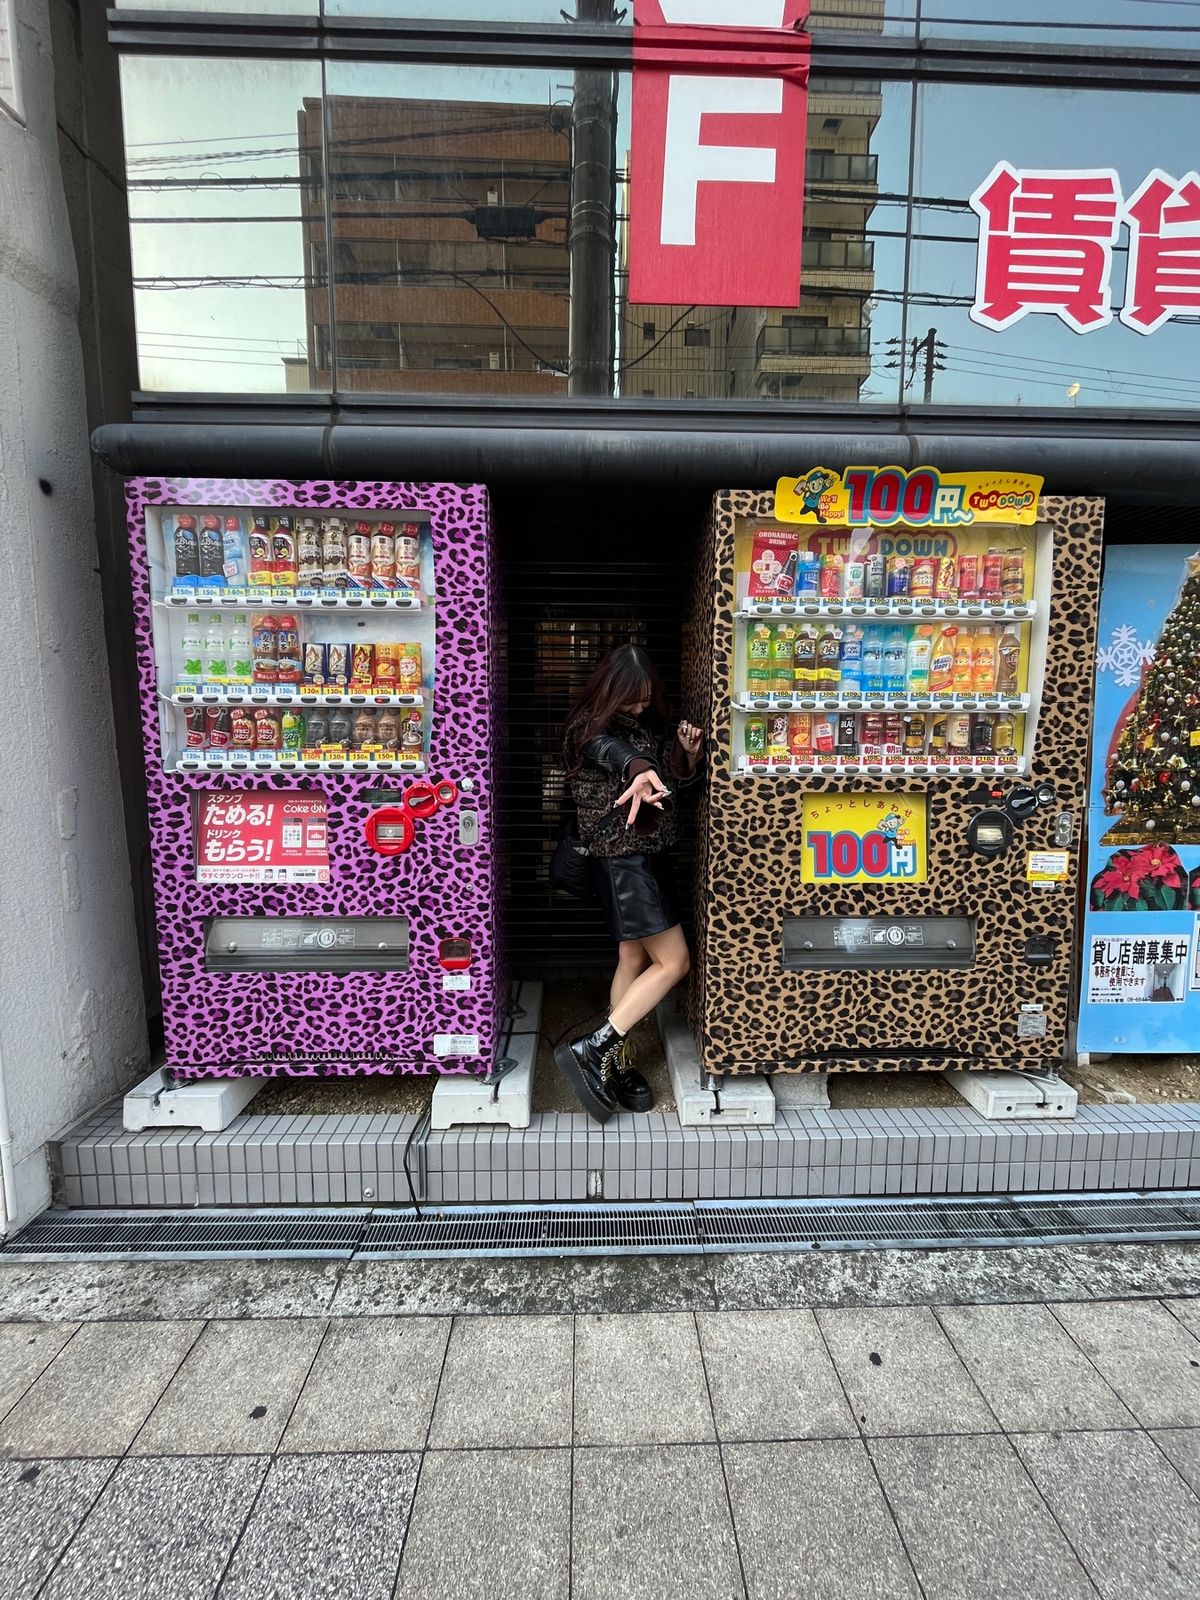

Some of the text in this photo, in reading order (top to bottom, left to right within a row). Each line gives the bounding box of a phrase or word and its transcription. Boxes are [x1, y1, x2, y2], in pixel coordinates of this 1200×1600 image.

[819, 495, 837, 504] We'll
[973, 492, 1033, 508] TWO DOWN
[819, 509, 844, 519] Happy!
[880, 538, 948, 557] DOWN
[207, 794, 244, 804] スタンプ
[203, 804, 275, 827] ためる!
[283, 803, 327, 814] Coke ON
[810, 799, 912, 820] ちょっとしあわせ
[207, 829, 242, 839] ドリンク
[204, 839, 274, 862] もらう!
[807, 831, 917, 878] 100円
[1092, 939, 1188, 965] 貸し店舗募集中
[1109, 977, 1146, 987] 使用できます
